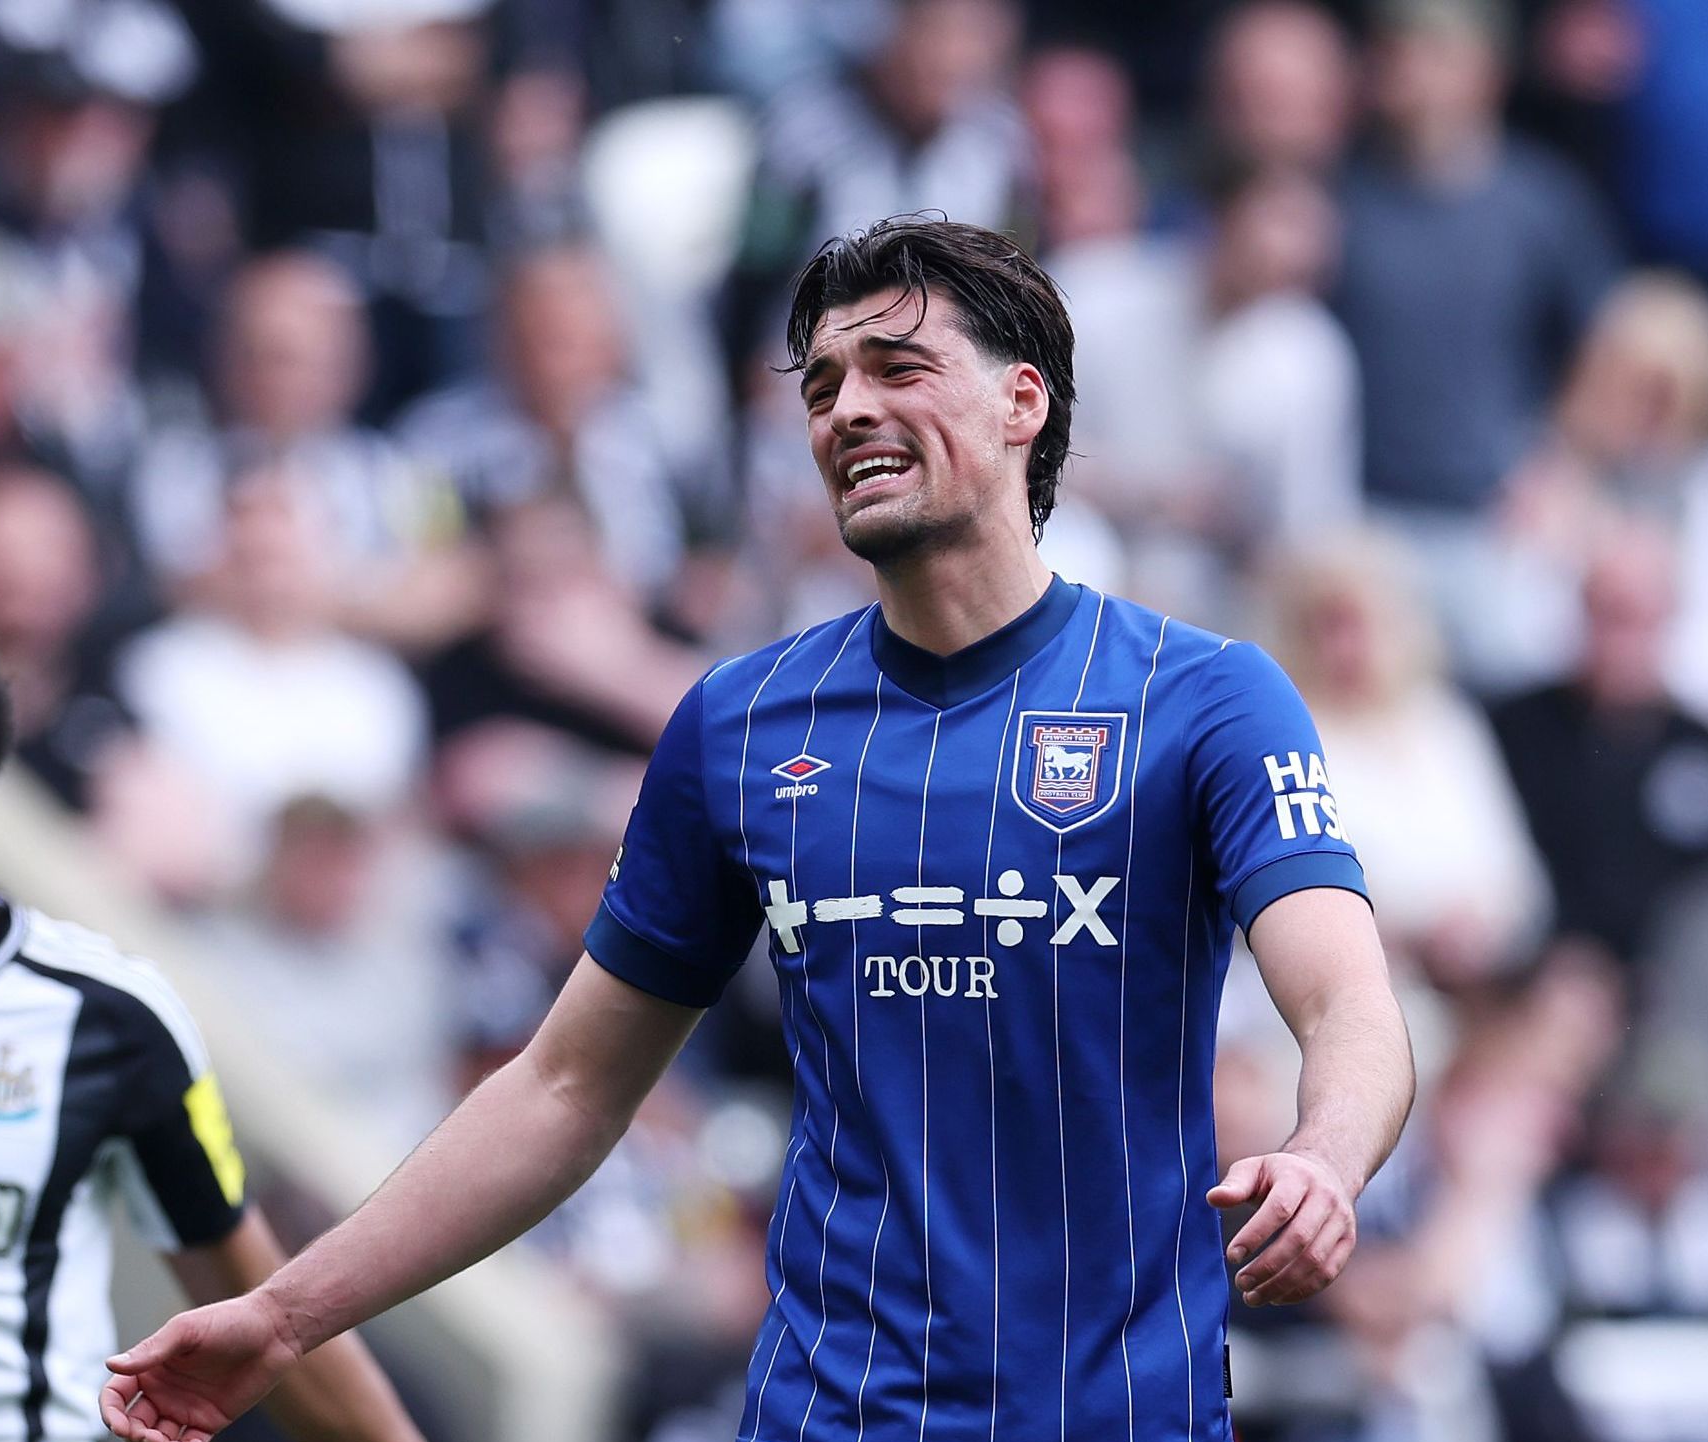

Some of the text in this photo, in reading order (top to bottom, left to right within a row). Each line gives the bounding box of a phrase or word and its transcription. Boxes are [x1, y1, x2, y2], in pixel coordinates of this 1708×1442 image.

[775, 782, 818, 799] umbro
[1263, 750, 1332, 793] HA
[1274, 791, 1352, 845] ITS
[863, 955, 999, 999] TOUR
